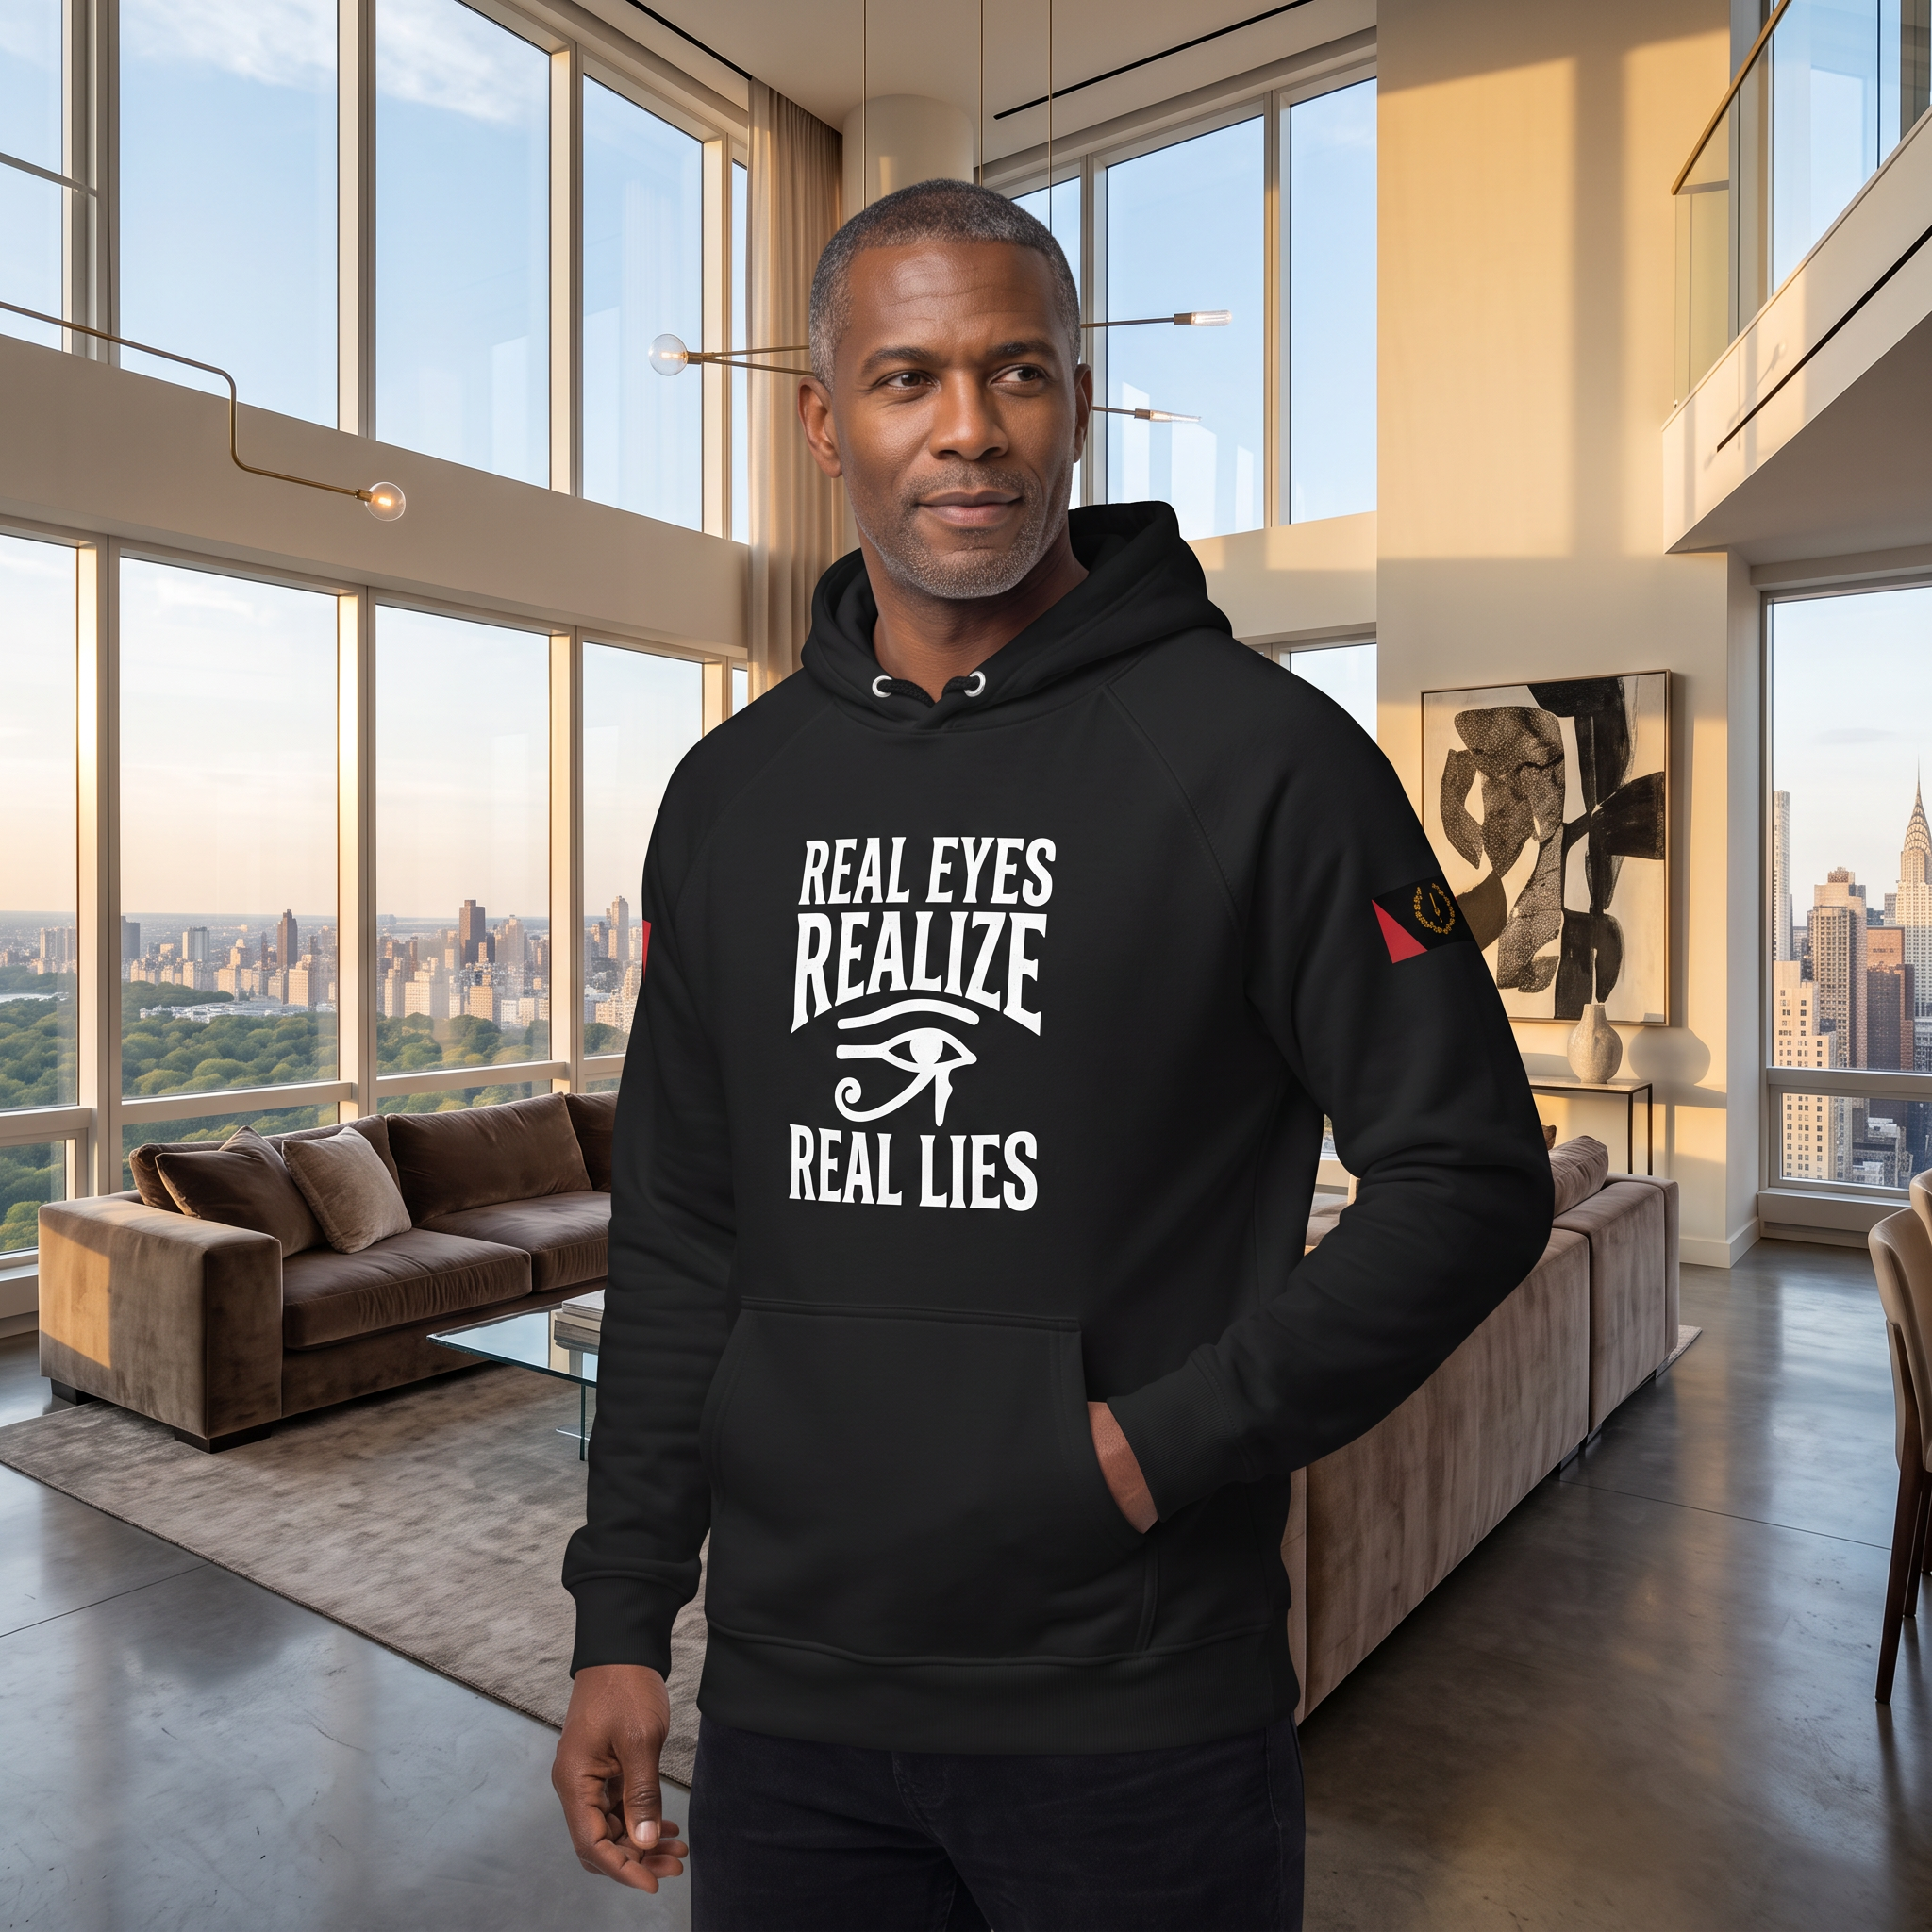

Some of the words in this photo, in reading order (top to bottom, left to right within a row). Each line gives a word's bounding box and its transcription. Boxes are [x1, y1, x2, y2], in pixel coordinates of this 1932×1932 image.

[798, 837, 909, 905] REAL
[925, 837, 1056, 907] EYES
[791, 911, 1047, 1036] REALIZE
[789, 1124, 902, 1205] REAL
[920, 1131, 1038, 1211] LIES
